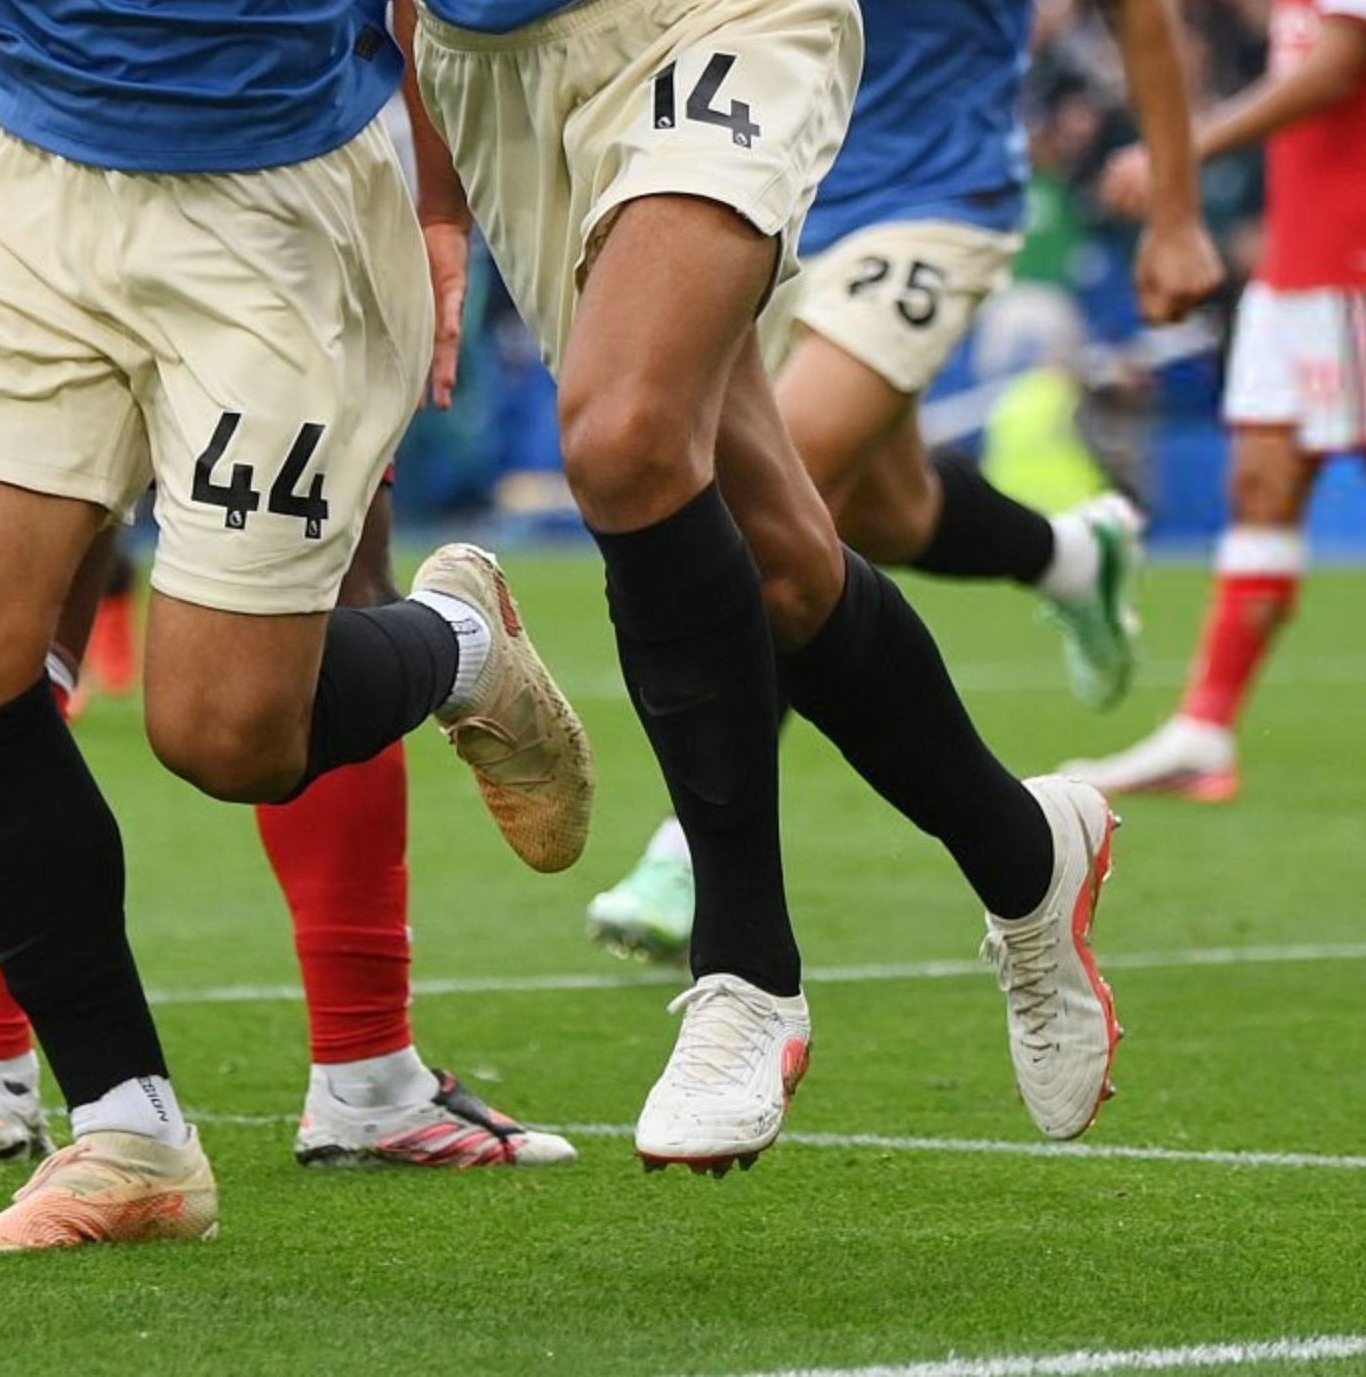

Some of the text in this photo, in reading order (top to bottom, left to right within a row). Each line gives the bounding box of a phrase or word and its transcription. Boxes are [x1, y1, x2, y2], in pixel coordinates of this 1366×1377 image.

[651, 52, 761, 149] 14
[848, 254, 947, 329] 25
[191, 411, 329, 540] 44
